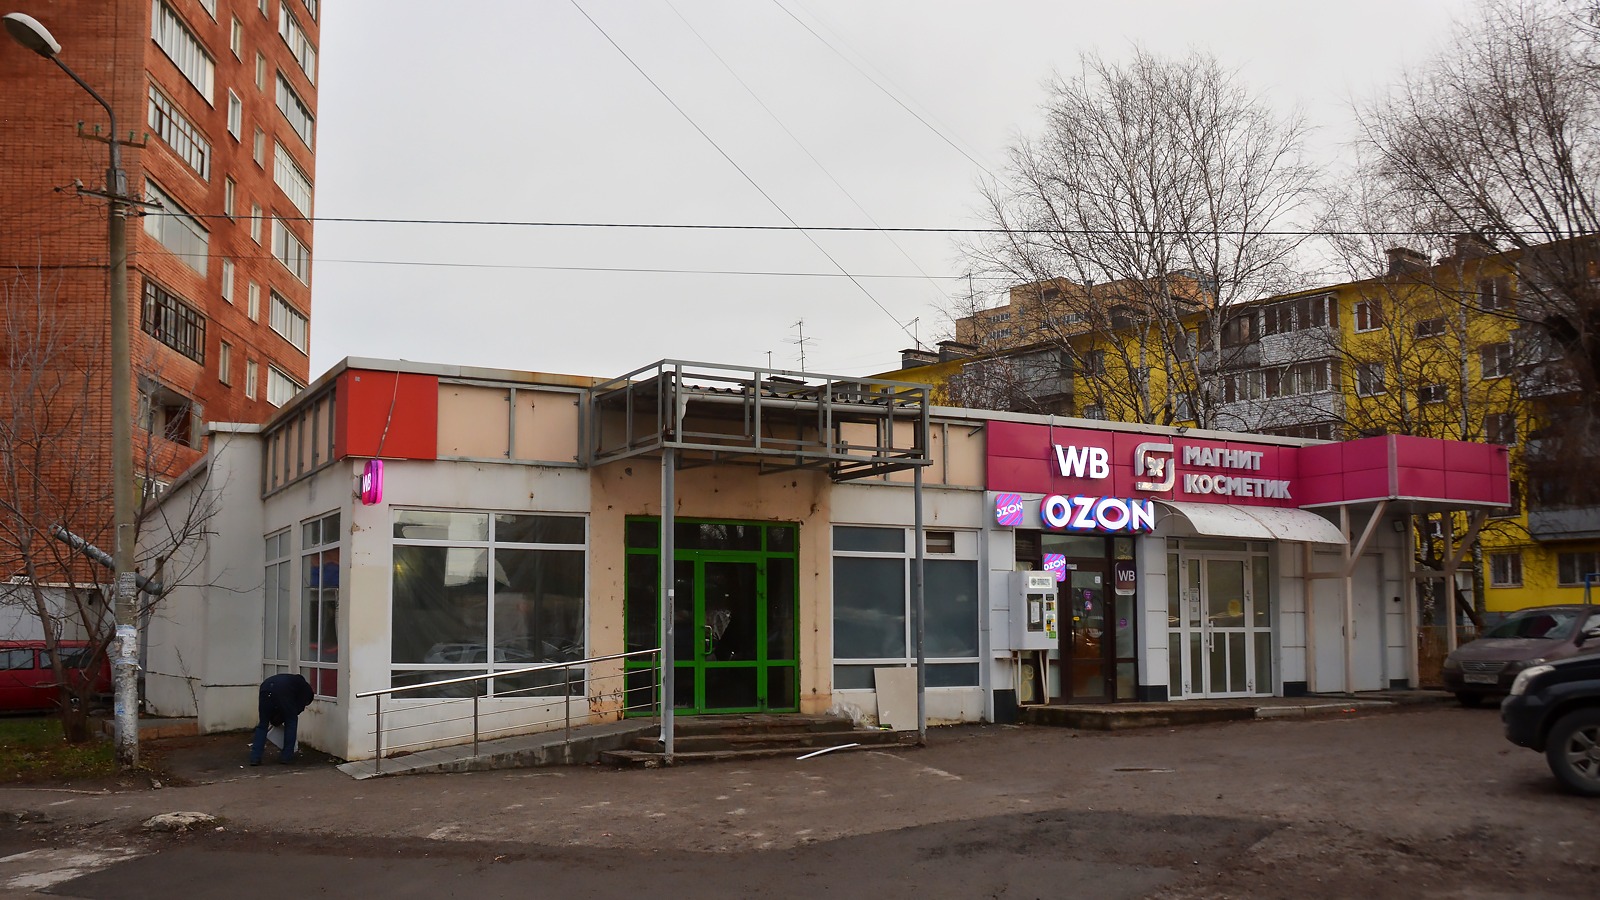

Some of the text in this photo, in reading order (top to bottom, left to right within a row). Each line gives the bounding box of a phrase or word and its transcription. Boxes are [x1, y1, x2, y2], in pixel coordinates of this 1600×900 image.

[1055, 444, 1110, 479] WB
[1182, 445, 1264, 470] МАГНИТ
[362, 472, 372, 493] WB
[1183, 474, 1292, 499] КОСМЕТИК
[996, 502, 1024, 518] OZON
[1043, 494, 1155, 533] OZON
[1044, 558, 1067, 571] OZON
[1118, 570, 1136, 582] WB
